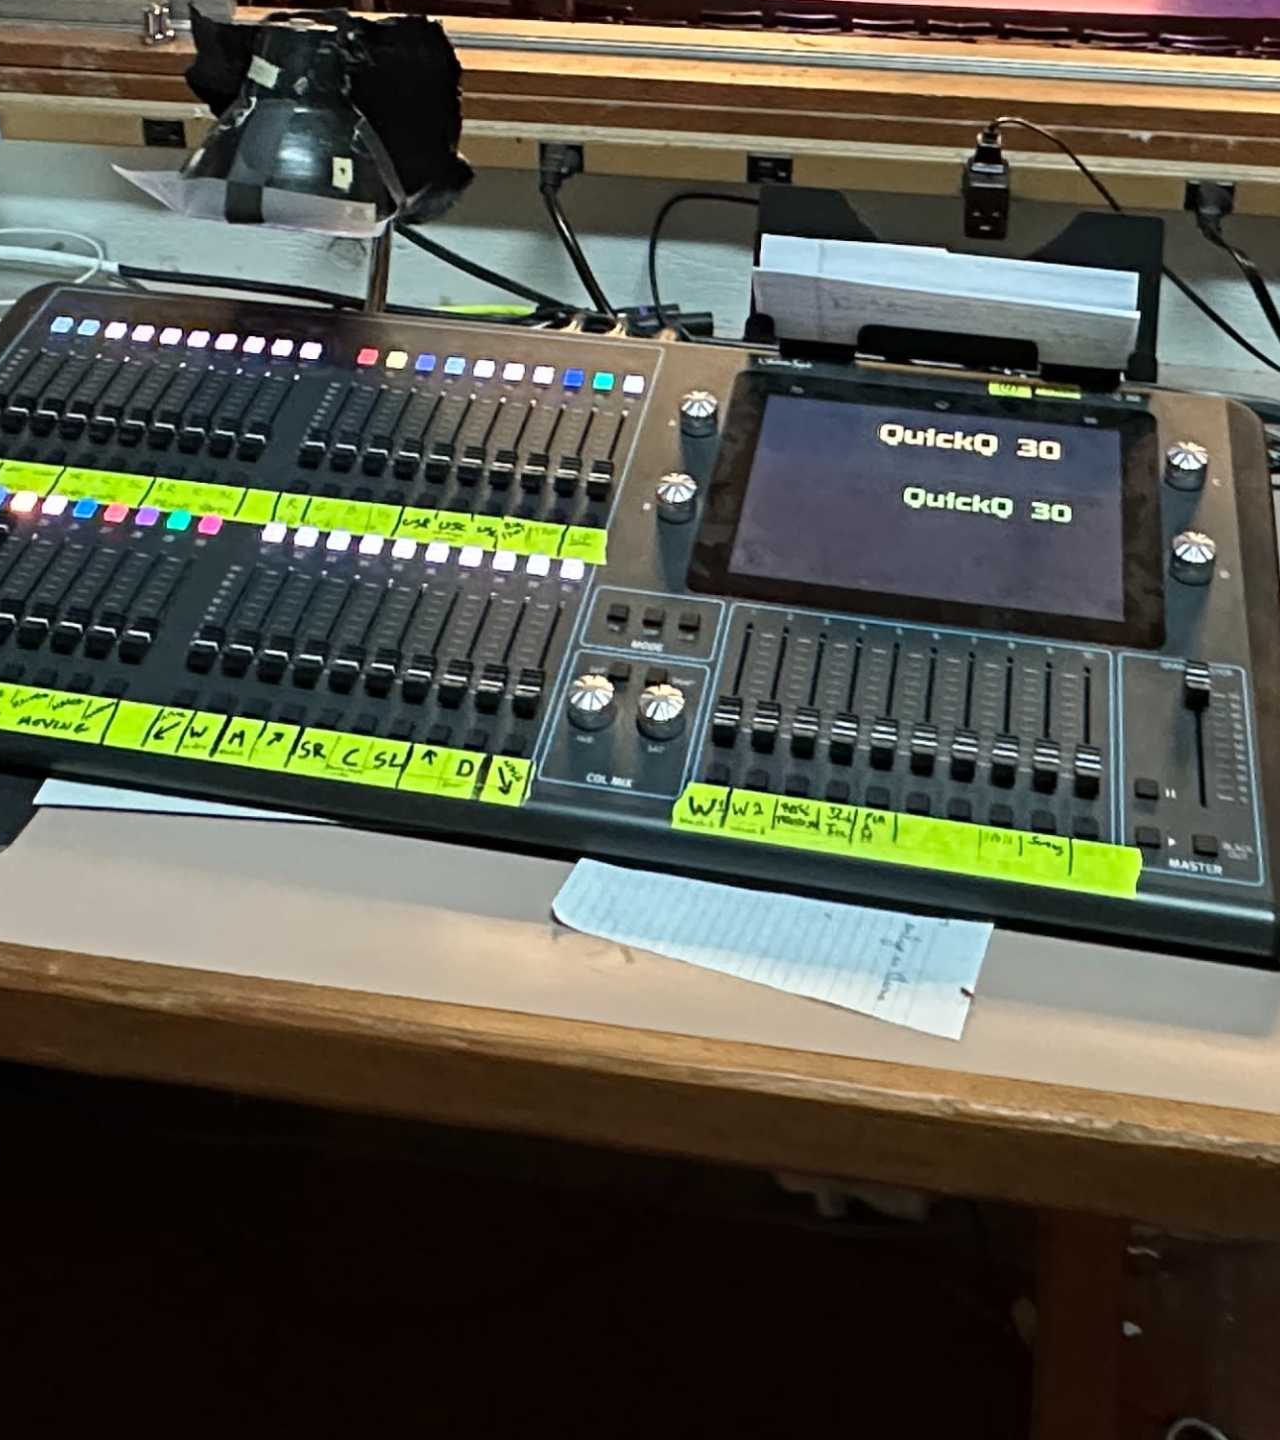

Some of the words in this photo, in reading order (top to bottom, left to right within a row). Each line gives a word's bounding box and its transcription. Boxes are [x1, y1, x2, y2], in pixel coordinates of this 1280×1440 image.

[879, 423, 999, 457] QuickQ
[1016, 438, 1062, 461] 30
[903, 486, 1014, 518] QuickQ
[1030, 501, 1073, 524] 30
[16, 715, 91, 735] MOVING
[298, 740, 327, 760] SR
[342, 748, 360, 767] C
[374, 752, 403, 769] SL
[456, 759, 474, 777] D
[1168, 858, 1223, 876] MASTER
